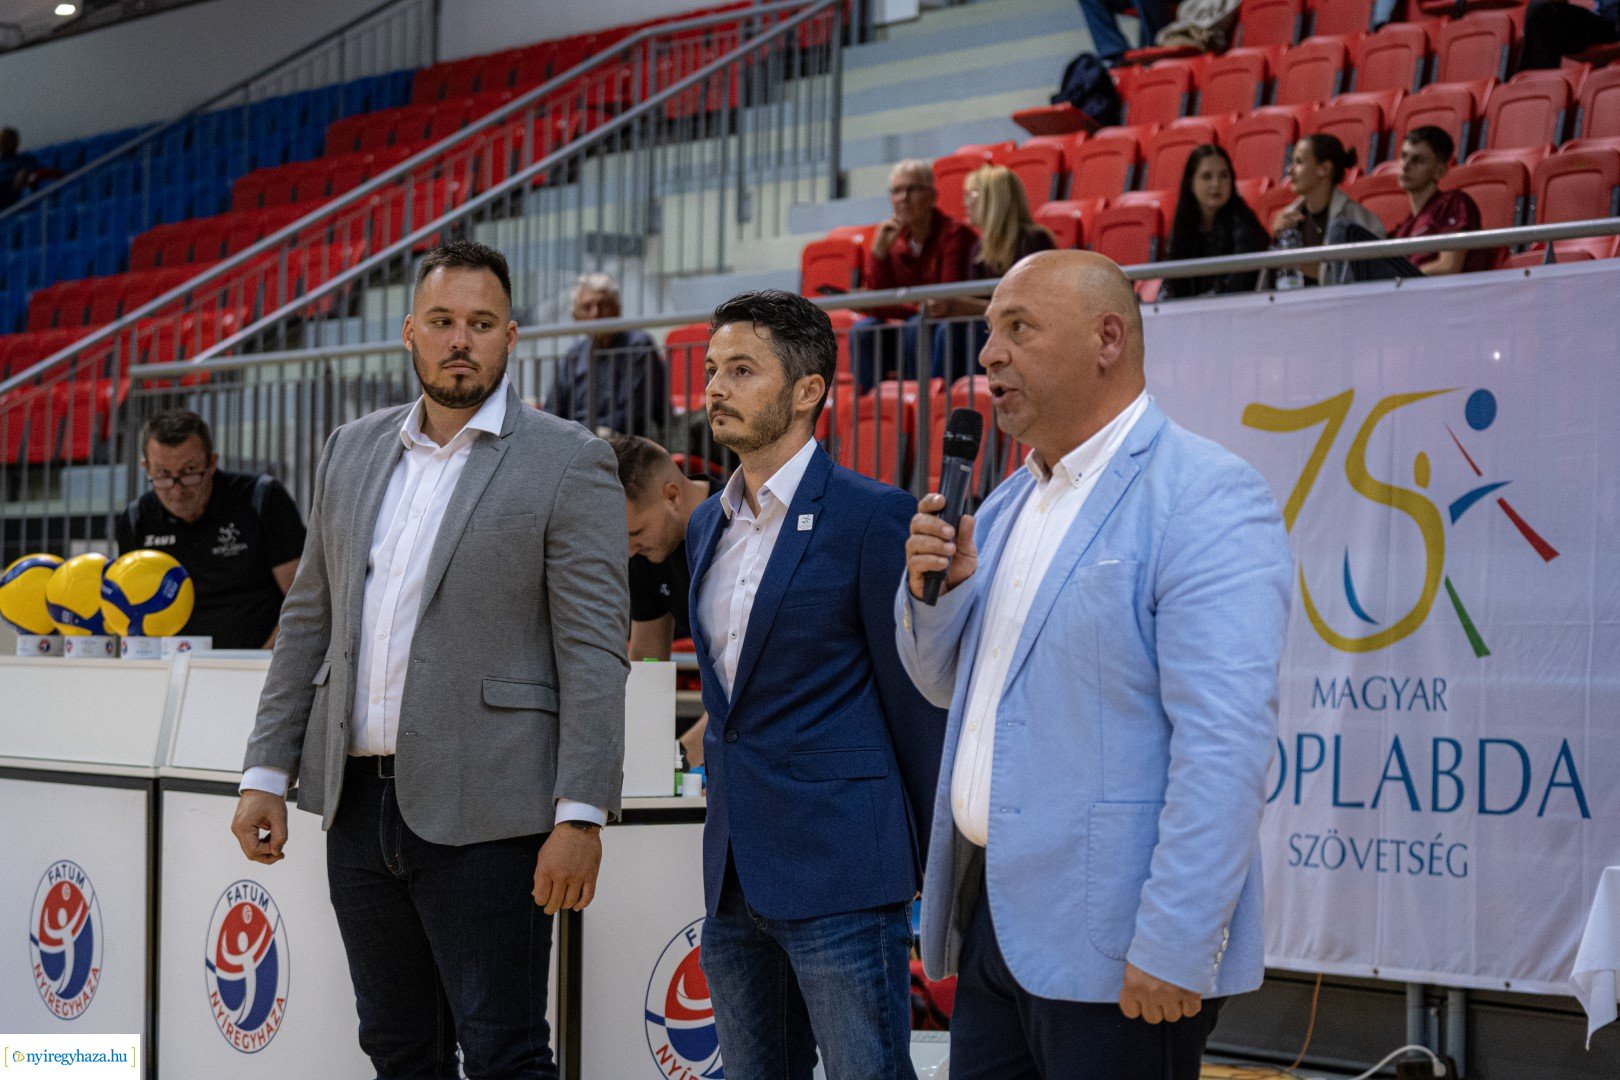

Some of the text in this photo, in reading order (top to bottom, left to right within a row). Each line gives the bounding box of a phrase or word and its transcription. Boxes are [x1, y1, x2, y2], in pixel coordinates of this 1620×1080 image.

[1312, 675, 1449, 711] MAGYAR
[1288, 829, 1469, 879] SZÖVETSÉG
[48, 864, 86, 890] FATUM
[226, 884, 270, 912] FATUM
